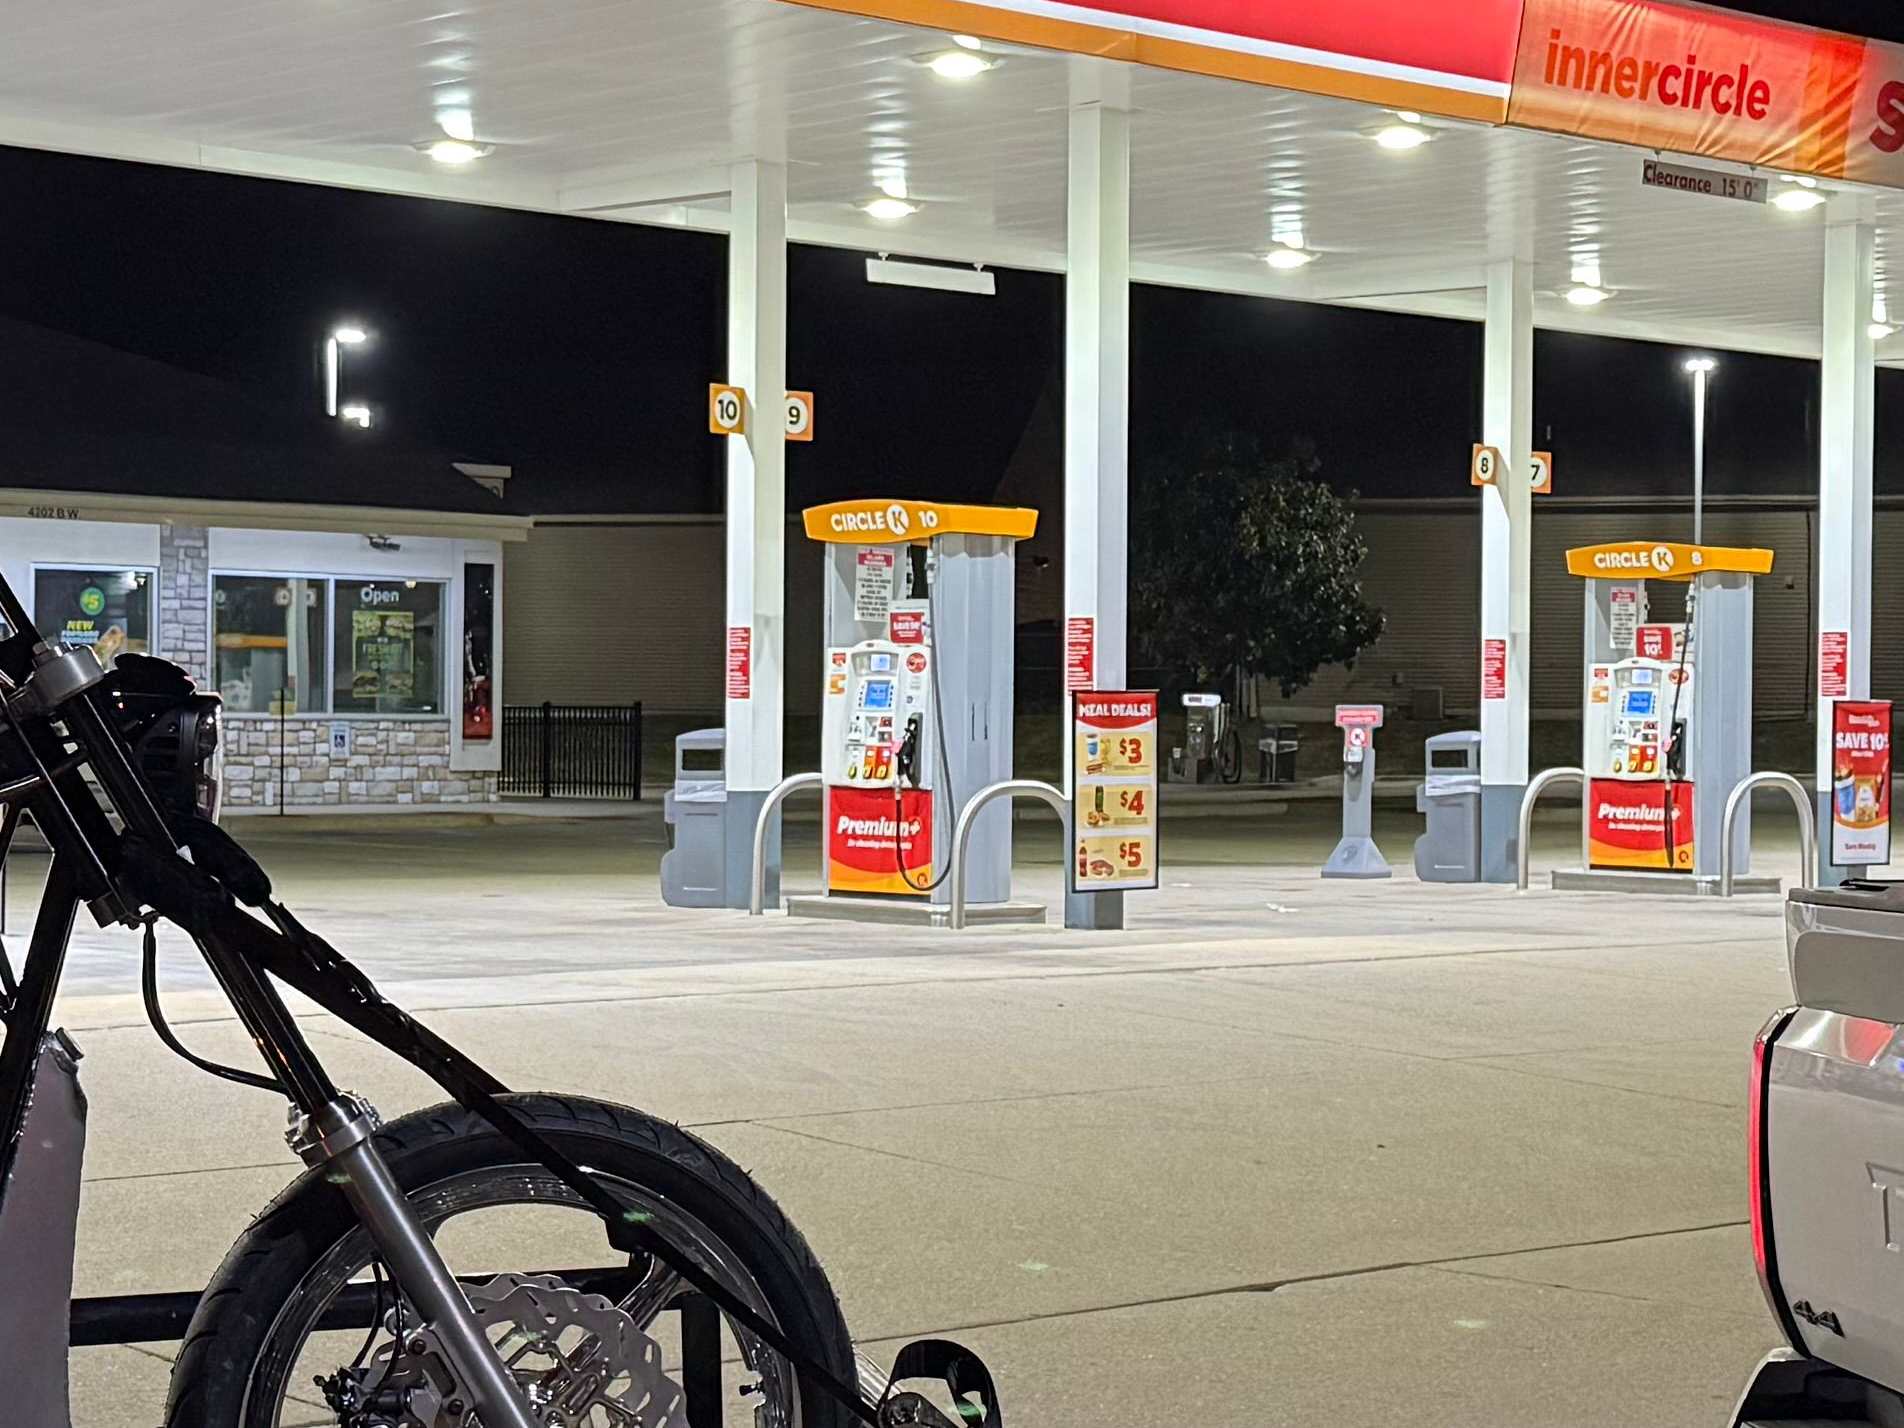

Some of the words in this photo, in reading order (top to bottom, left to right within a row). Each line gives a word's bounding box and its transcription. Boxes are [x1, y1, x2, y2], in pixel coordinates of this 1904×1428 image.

[1544, 28, 1770, 120] innercircle
[1644, 164, 1712, 193] Clearance
[718, 399, 738, 420] 10
[788, 406, 800, 425] 9
[1480, 458, 1488, 474] 8
[1531, 464, 1540, 481] 7
[831, 511, 886, 532] CIRCLE
[889, 509, 908, 534] K
[918, 510, 938, 528] 10
[1594, 552, 1649, 569] CIRCLE
[1655, 550, 1672, 571] K
[361, 587, 399, 605] Open
[66, 620, 94, 631] NEW
[1077, 704, 1110, 719] MEAL
[1111, 704, 1152, 719] DEALS!
[1119, 738, 1142, 764] $3
[1836, 732, 1868, 749] SAVE
[1120, 790, 1144, 816] $4
[1119, 842, 1142, 868] $5
